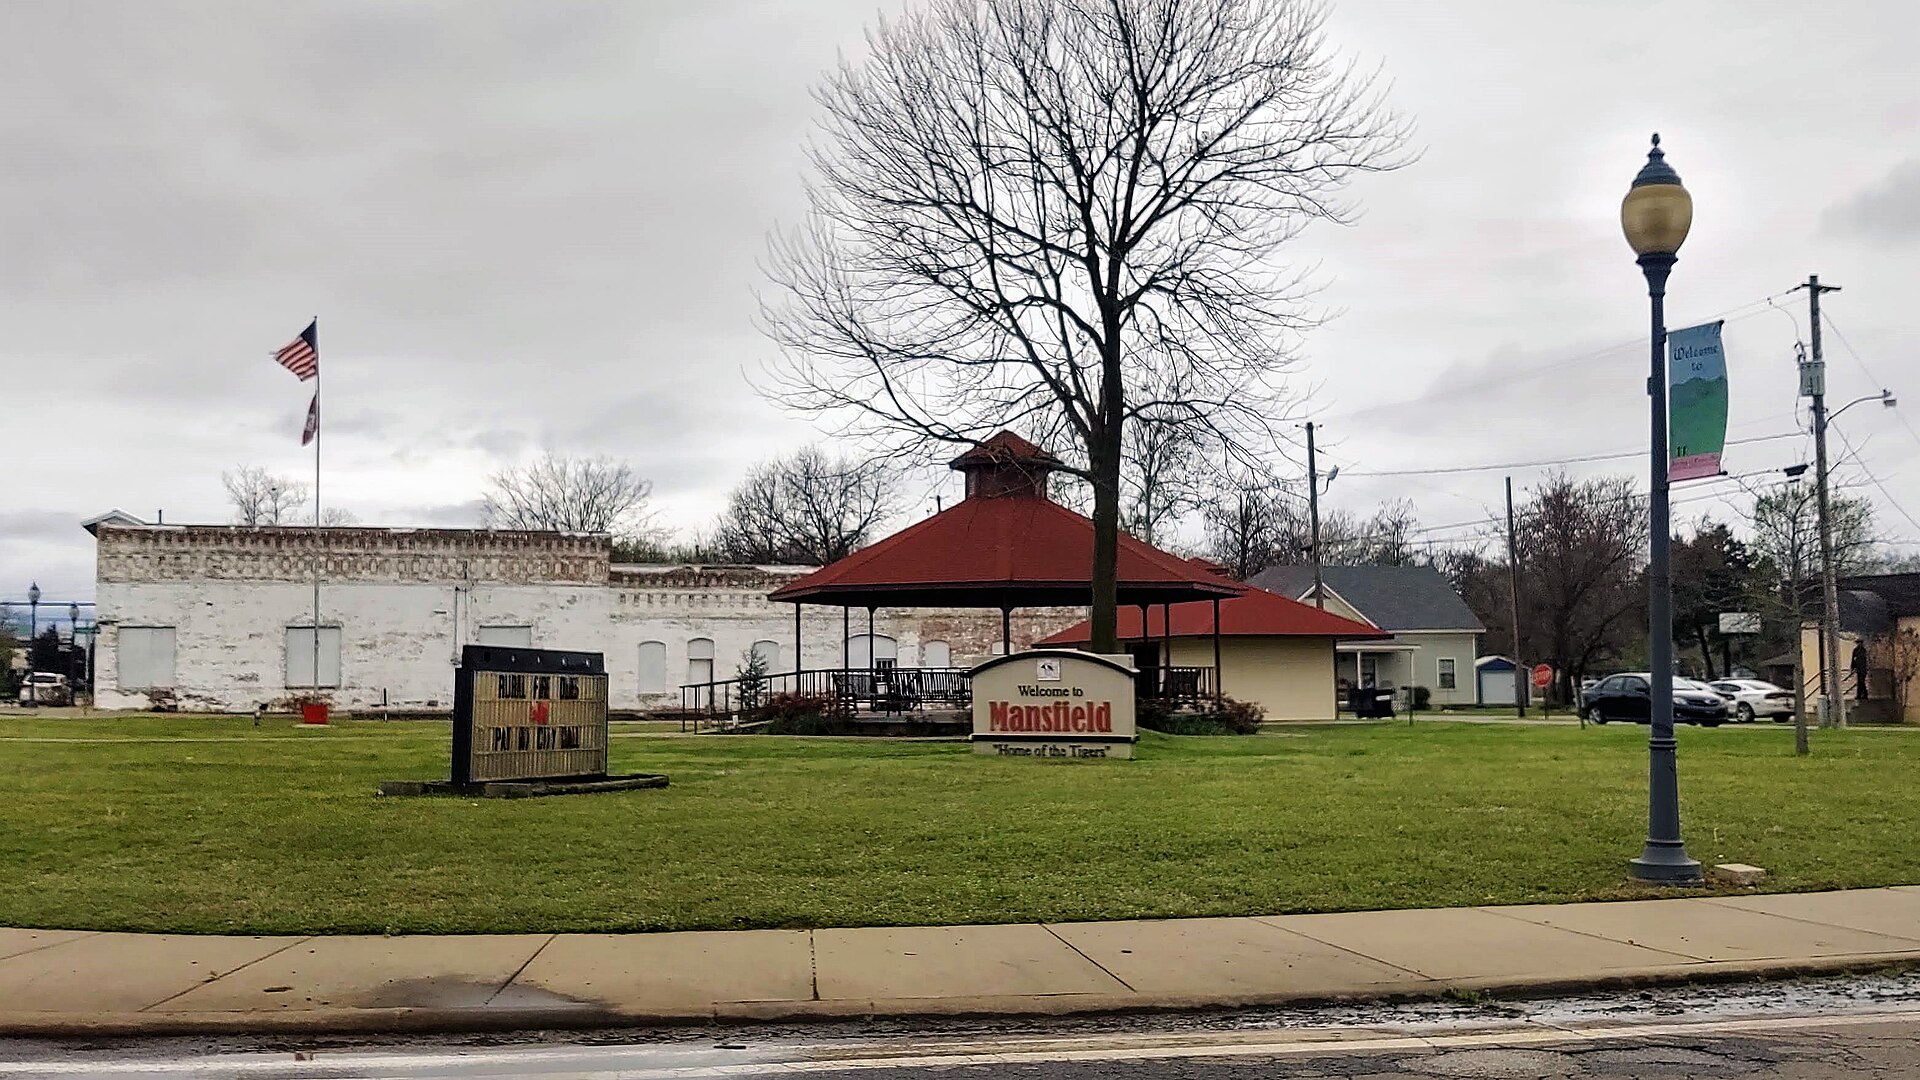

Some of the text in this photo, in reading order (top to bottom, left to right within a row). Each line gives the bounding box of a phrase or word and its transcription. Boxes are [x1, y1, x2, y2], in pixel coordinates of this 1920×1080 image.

[1674, 345, 1718, 361] Welcome
[1533, 670, 1552, 681] STOP
[1018, 685, 1084, 697] Welcome to
[989, 701, 1112, 733] Mansfield
[993, 744, 1111, 758] "Home of the Tigers"
